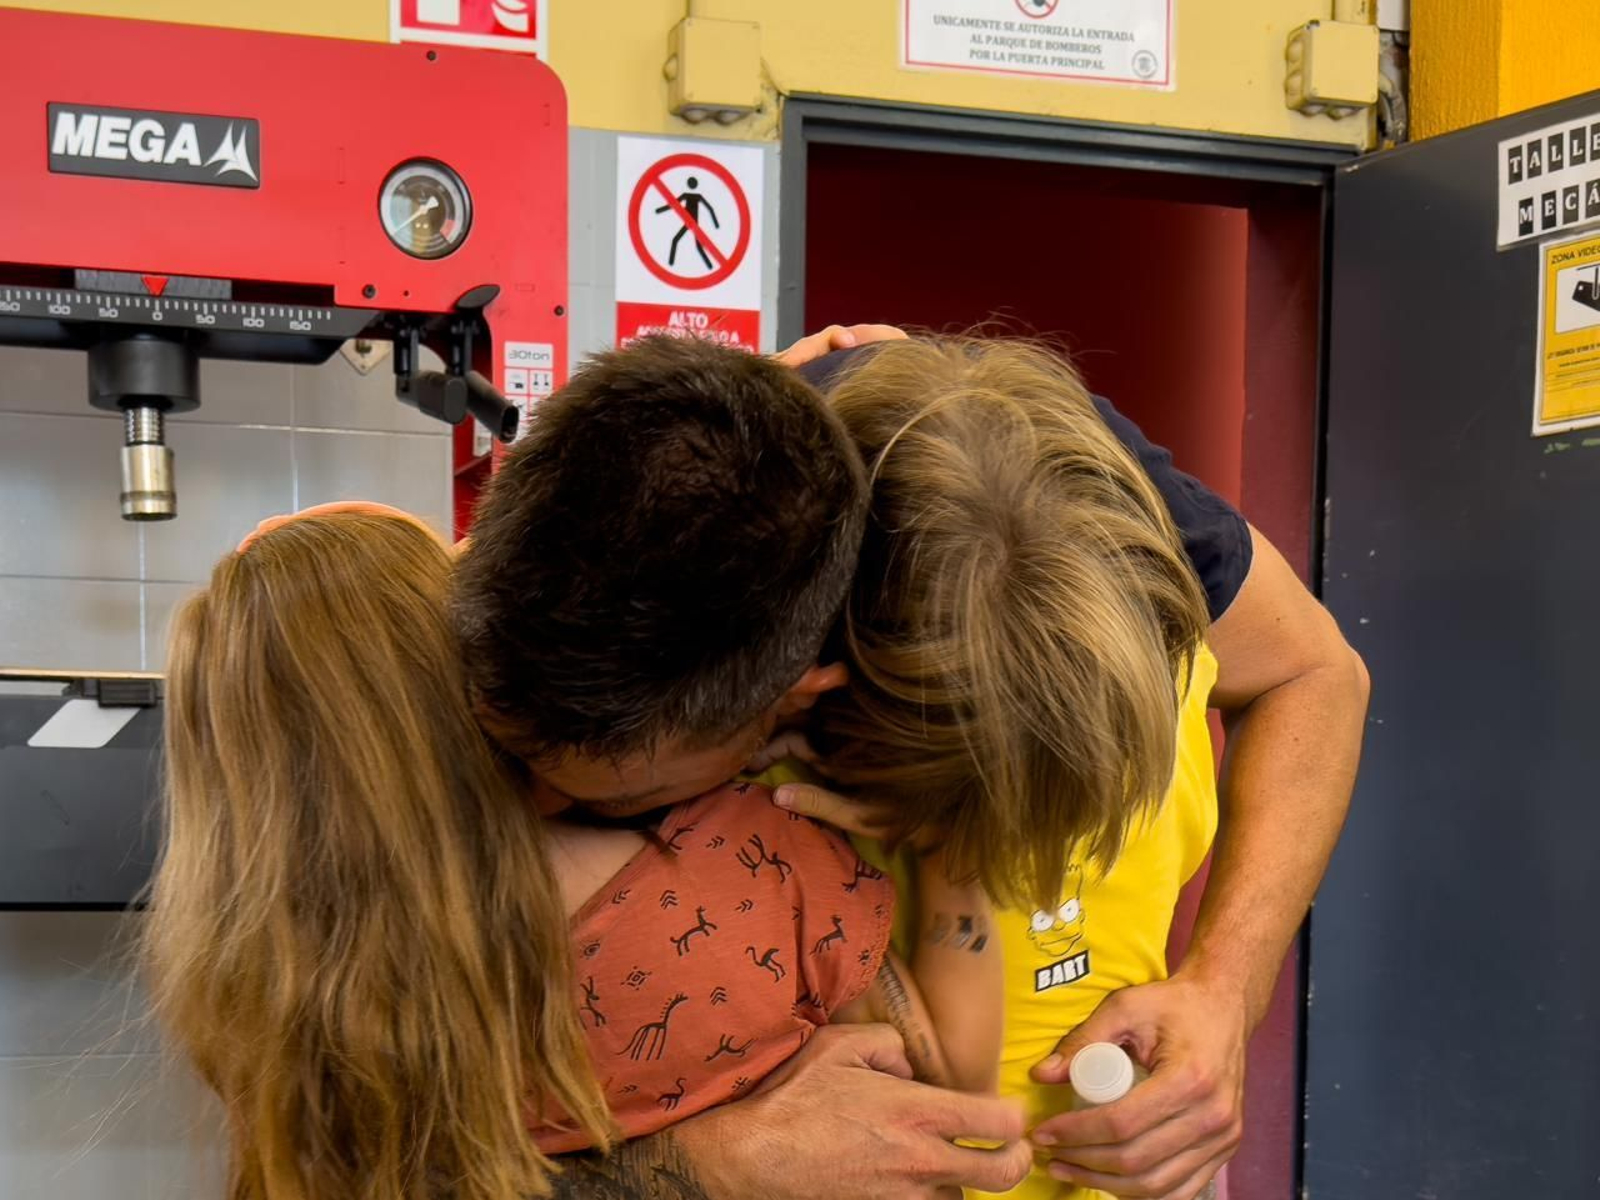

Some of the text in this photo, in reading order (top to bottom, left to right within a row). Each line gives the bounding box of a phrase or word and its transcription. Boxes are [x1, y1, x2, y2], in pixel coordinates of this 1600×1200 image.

[933, 14, 1135, 42] UNICAMENTE SE AUTORIZA LA ENTRADA
[970, 33, 1102, 54] AL PARQUE DE BOMBEROS
[969, 49, 1105, 70] POR LA PUERTA PRINCIPAL
[52, 111, 202, 167] MEGA
[1509, 133, 1600, 174] TALLE
[1519, 182, 1600, 225] MECÁ
[49, 304, 71, 316] 100
[100, 308, 118, 319] 50
[152, 311, 163, 322] 0
[196, 314, 215, 325] 50
[243, 317, 266, 328] 100
[289, 320, 312, 331] 150
[668, 311, 708, 329] ALTO
[1037, 954, 1086, 990] BART
